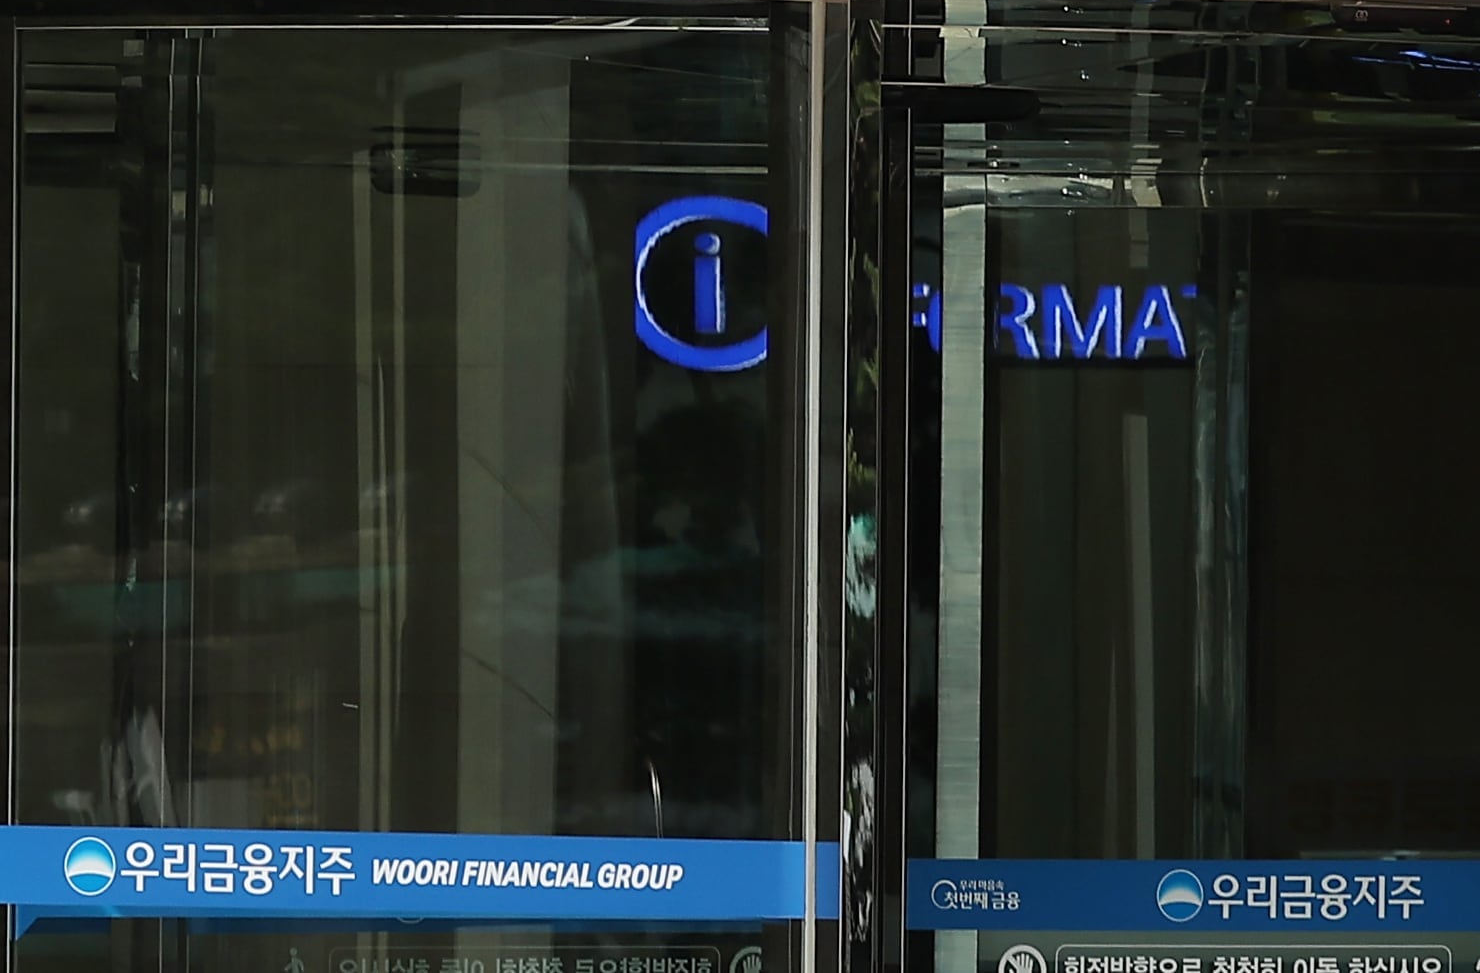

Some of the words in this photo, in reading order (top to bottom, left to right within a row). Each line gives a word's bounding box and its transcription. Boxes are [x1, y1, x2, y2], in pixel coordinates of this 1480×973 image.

[120, 841, 356, 896] 우리금융지주
[372, 858, 457, 886] WOORI
[461, 860, 595, 888] FINANCIAL
[597, 862, 684, 890] GROUP
[944, 891, 988, 910] 첫번째
[991, 891, 1021, 911] 금융
[1207, 873, 1425, 921] 우리금융지주
